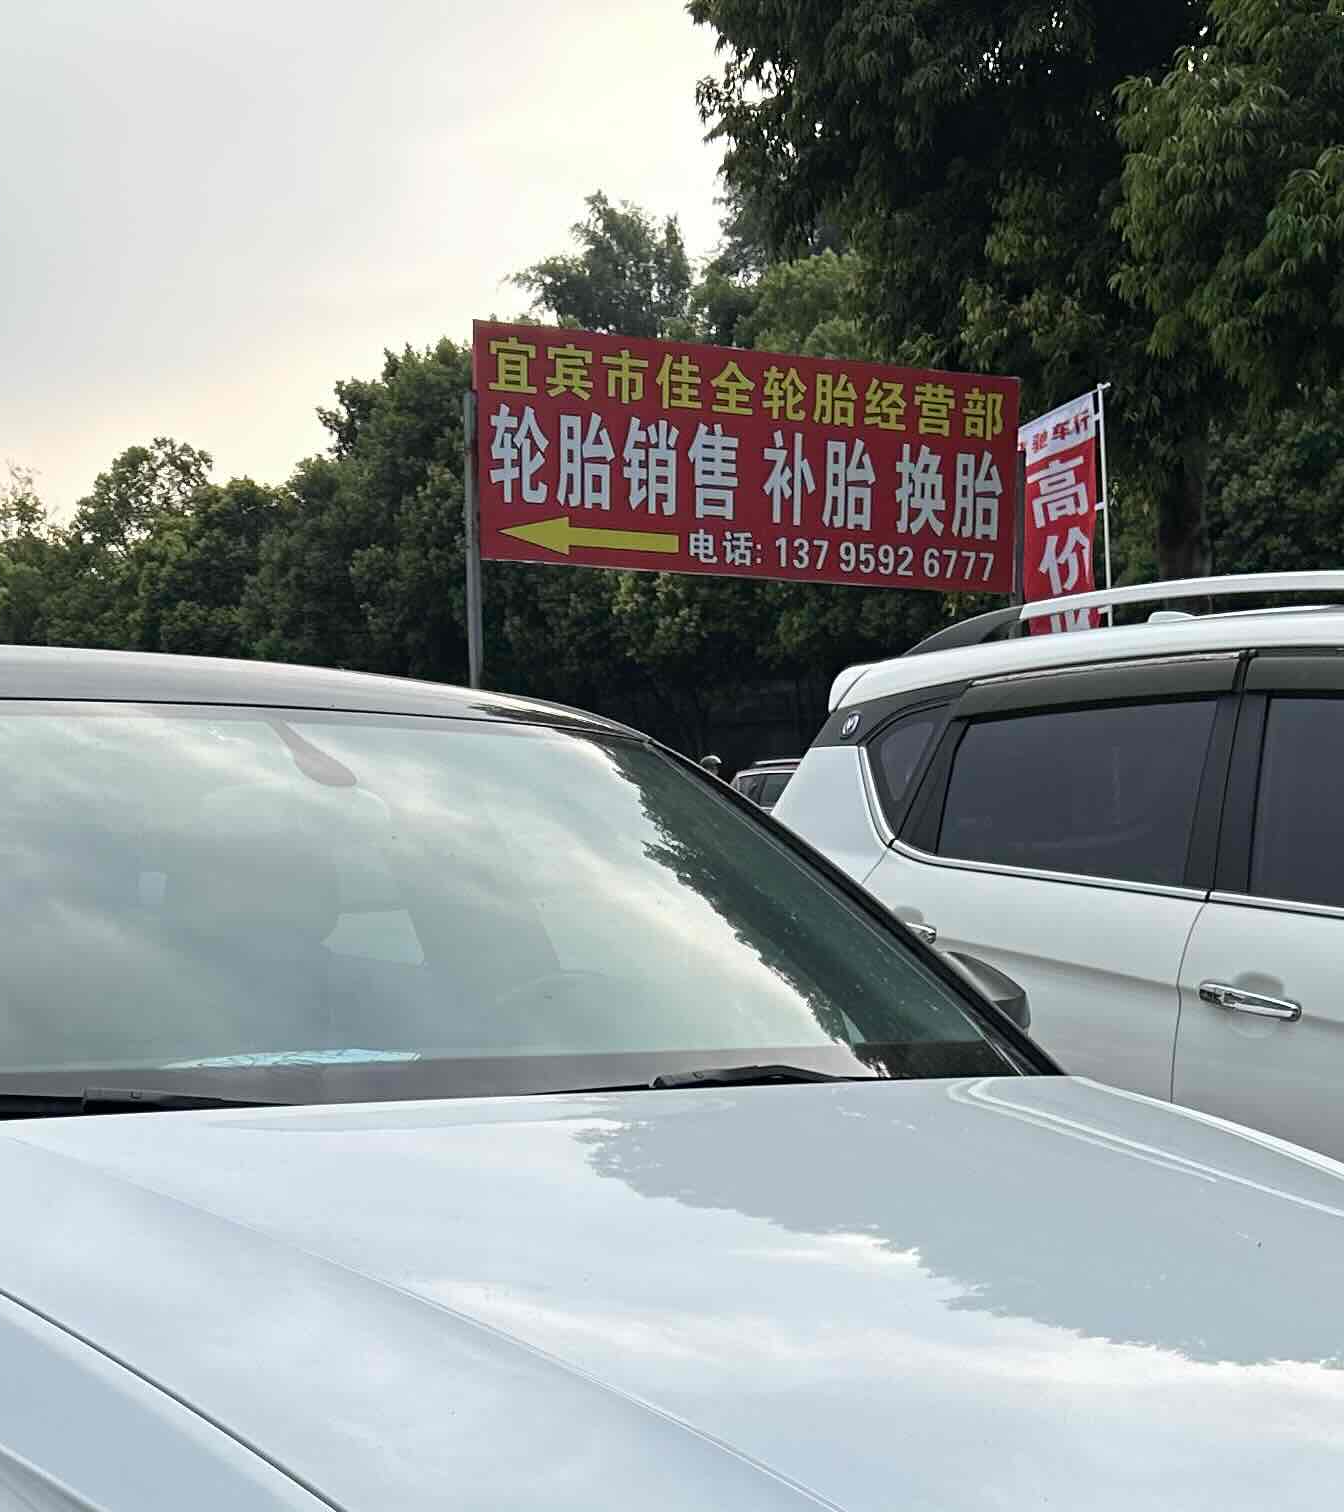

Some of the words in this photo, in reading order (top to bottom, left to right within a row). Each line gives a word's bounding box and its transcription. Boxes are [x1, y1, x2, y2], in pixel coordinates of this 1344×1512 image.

[488, 336, 1004, 440] 宜宾市佳全轮胎经营部
[1019, 409, 1091, 453] 驰车行
[489, 403, 739, 520] 轮胎销售
[763, 430, 876, 531] 补胎
[896, 443, 1003, 541] 换胎
[775, 537, 829, 570] 137
[839, 541, 913, 577] 9592
[923, 548, 994, 581] 6777
